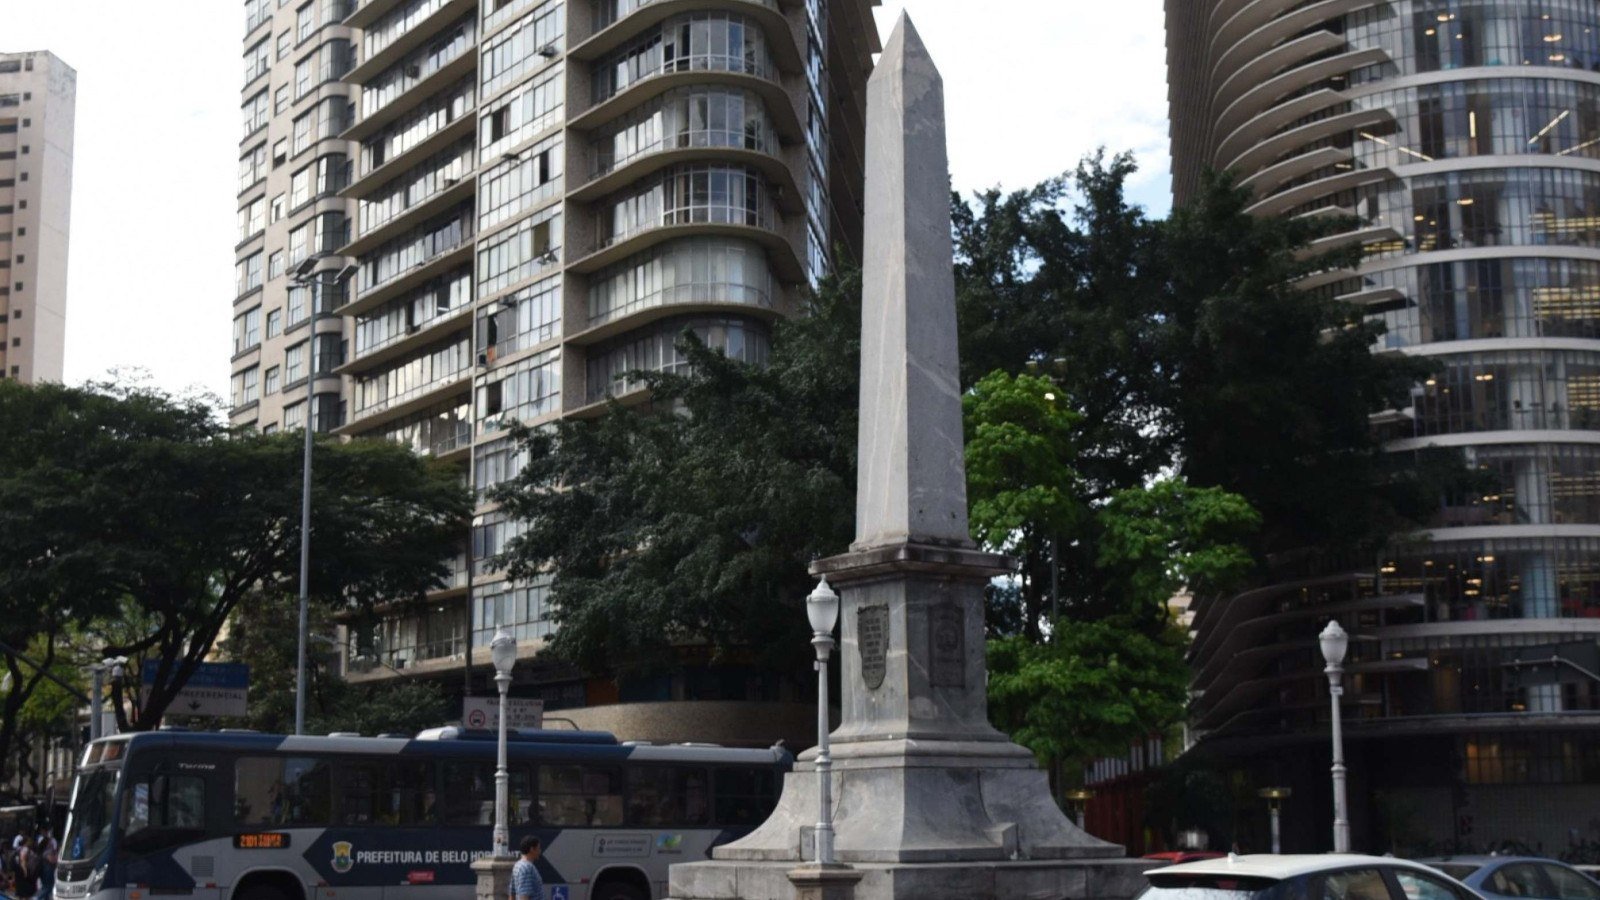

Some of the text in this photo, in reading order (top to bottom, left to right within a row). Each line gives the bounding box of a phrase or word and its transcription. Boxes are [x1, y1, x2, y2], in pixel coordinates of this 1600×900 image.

[356, 851, 422, 863] PREFEITURA
[424, 851, 439, 863] DE
[441, 851, 468, 863] BELO
